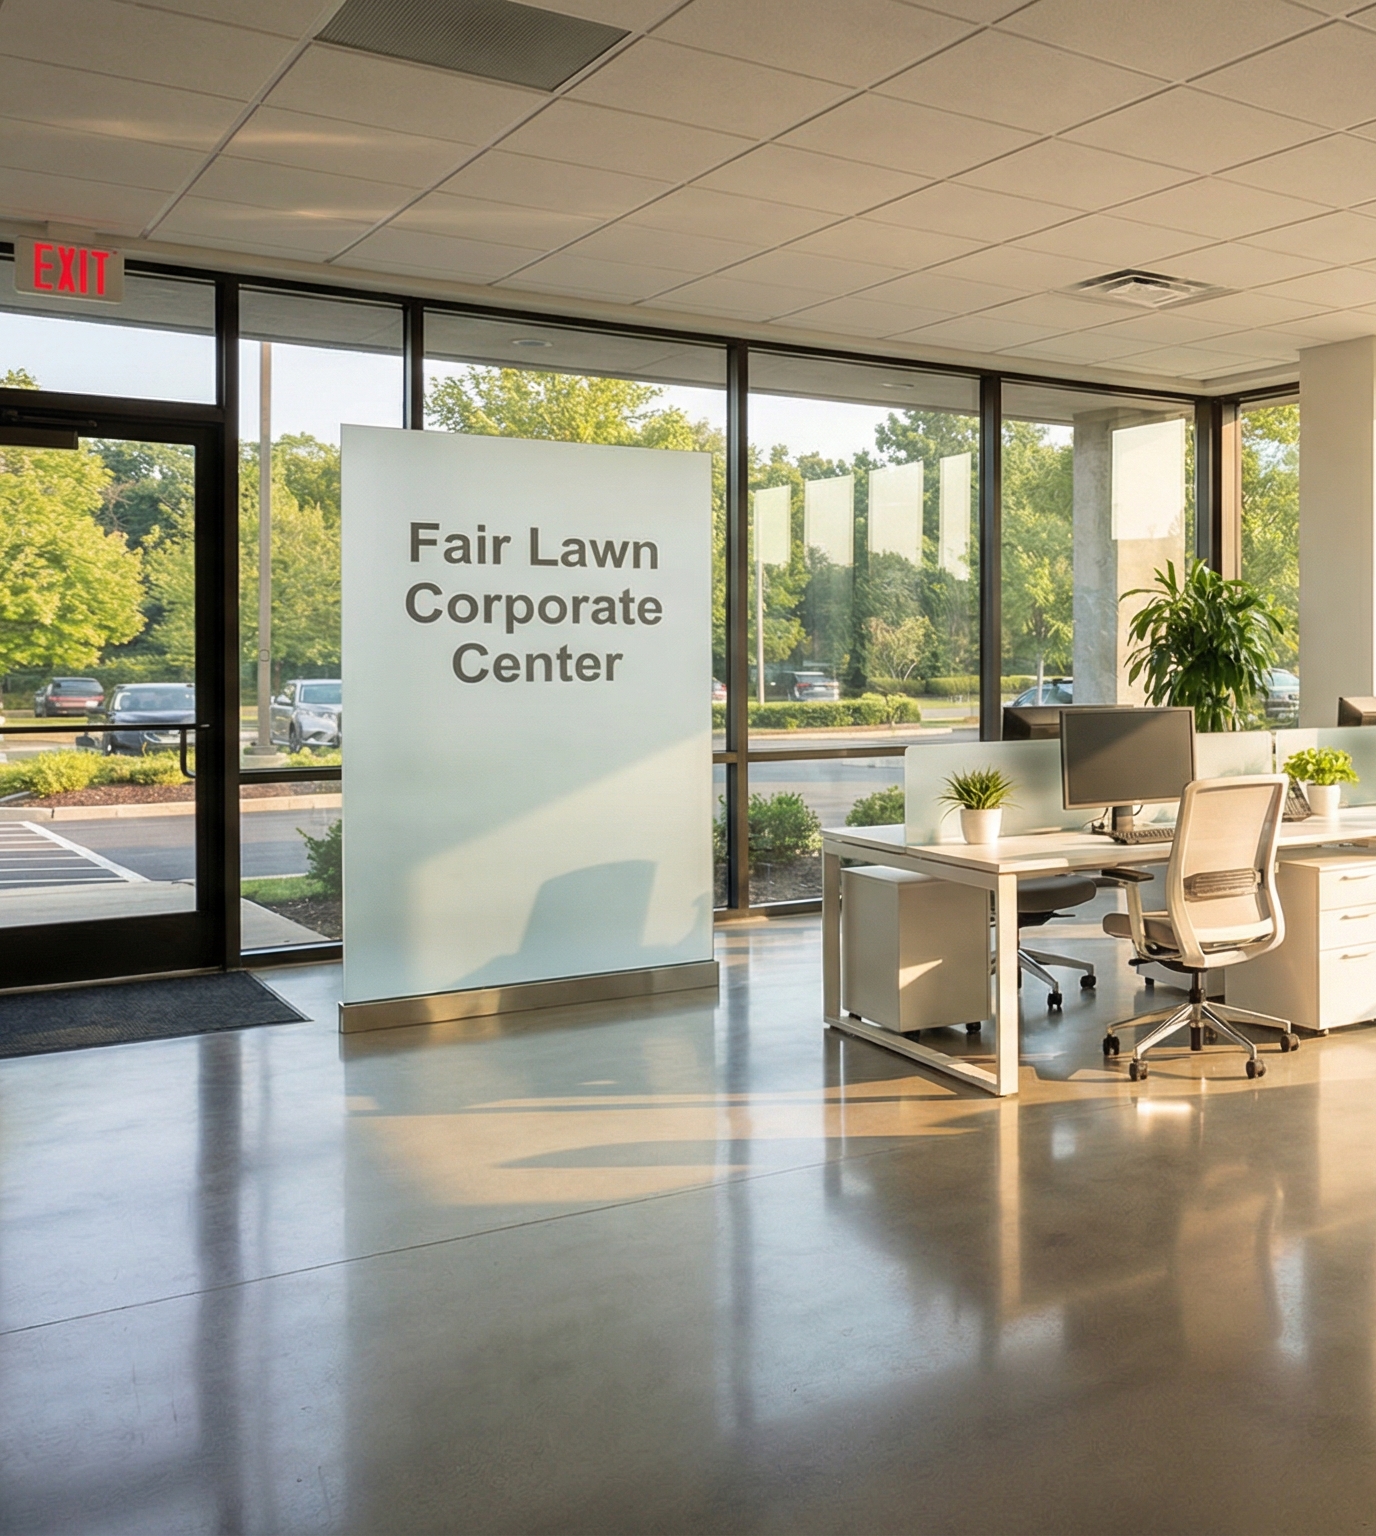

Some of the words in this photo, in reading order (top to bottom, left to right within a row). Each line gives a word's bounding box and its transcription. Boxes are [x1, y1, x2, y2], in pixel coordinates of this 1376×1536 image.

[33, 242, 110, 296] EXIT
[410, 520, 513, 566] Fair
[528, 526, 660, 570] Lawn
[405, 582, 664, 636] Corporate
[451, 641, 625, 684] Center
